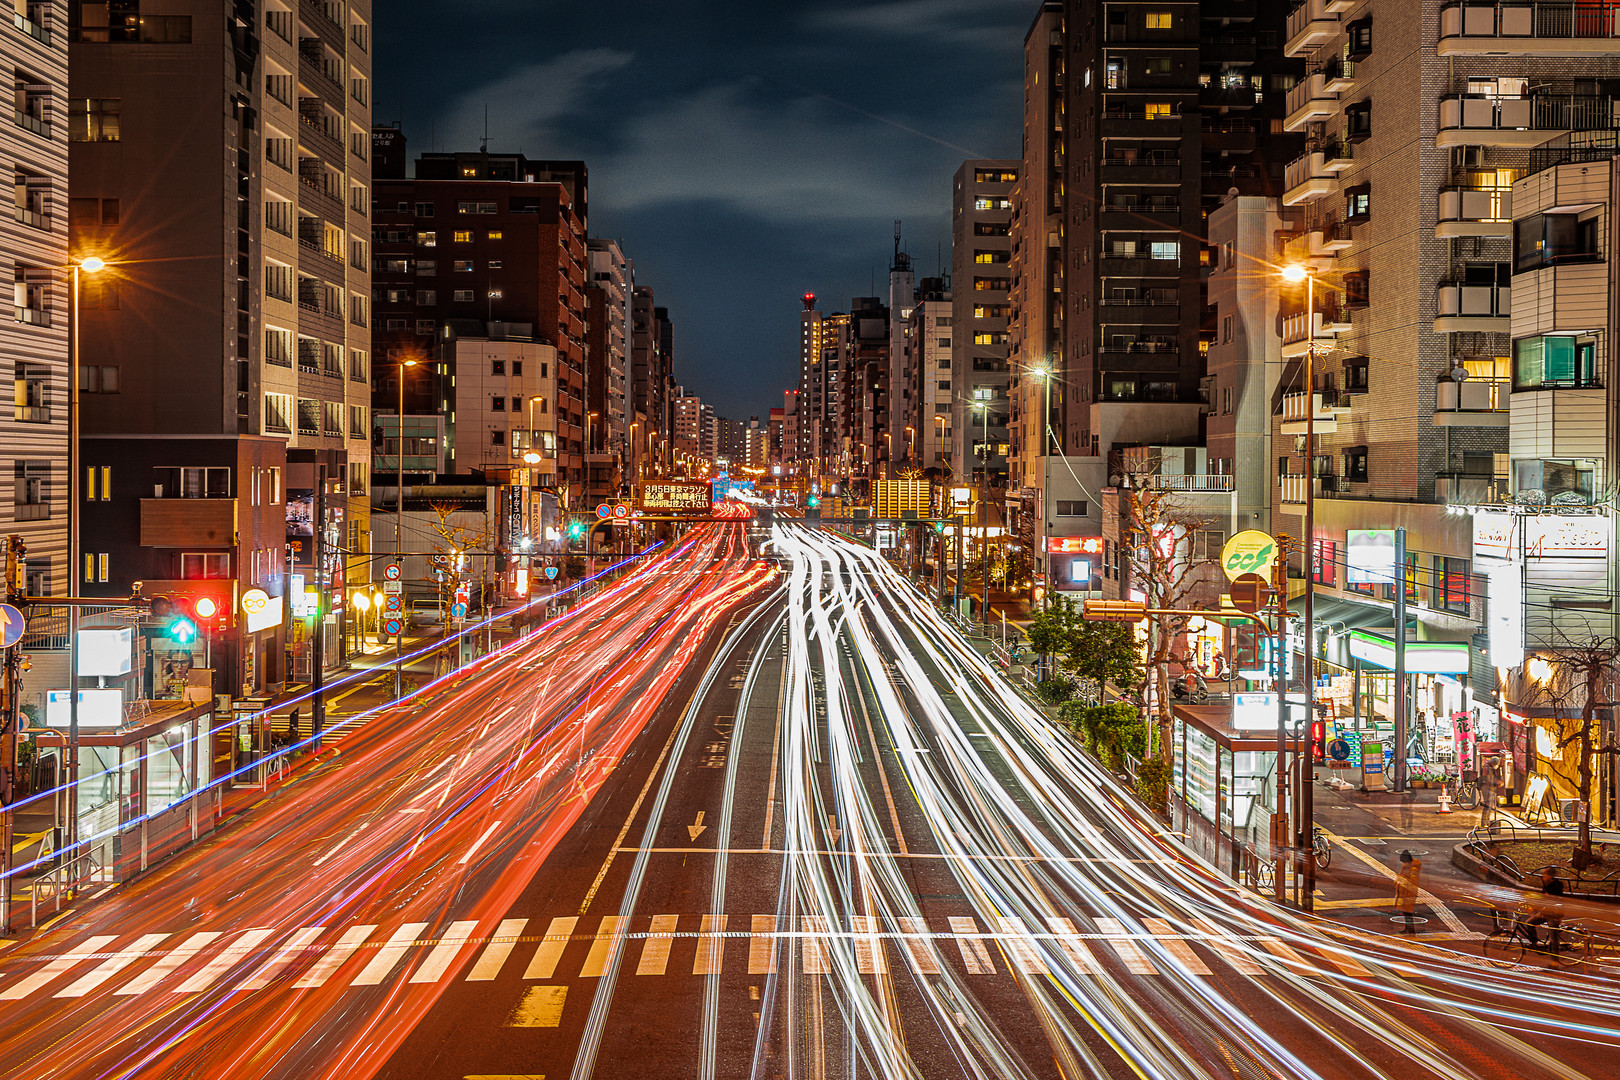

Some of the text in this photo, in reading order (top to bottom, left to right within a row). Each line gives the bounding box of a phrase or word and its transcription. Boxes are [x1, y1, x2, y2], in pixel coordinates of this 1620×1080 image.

[926, 319, 934, 343] SINCE
[645, 485, 708, 493] 3月5日東京マラソン
